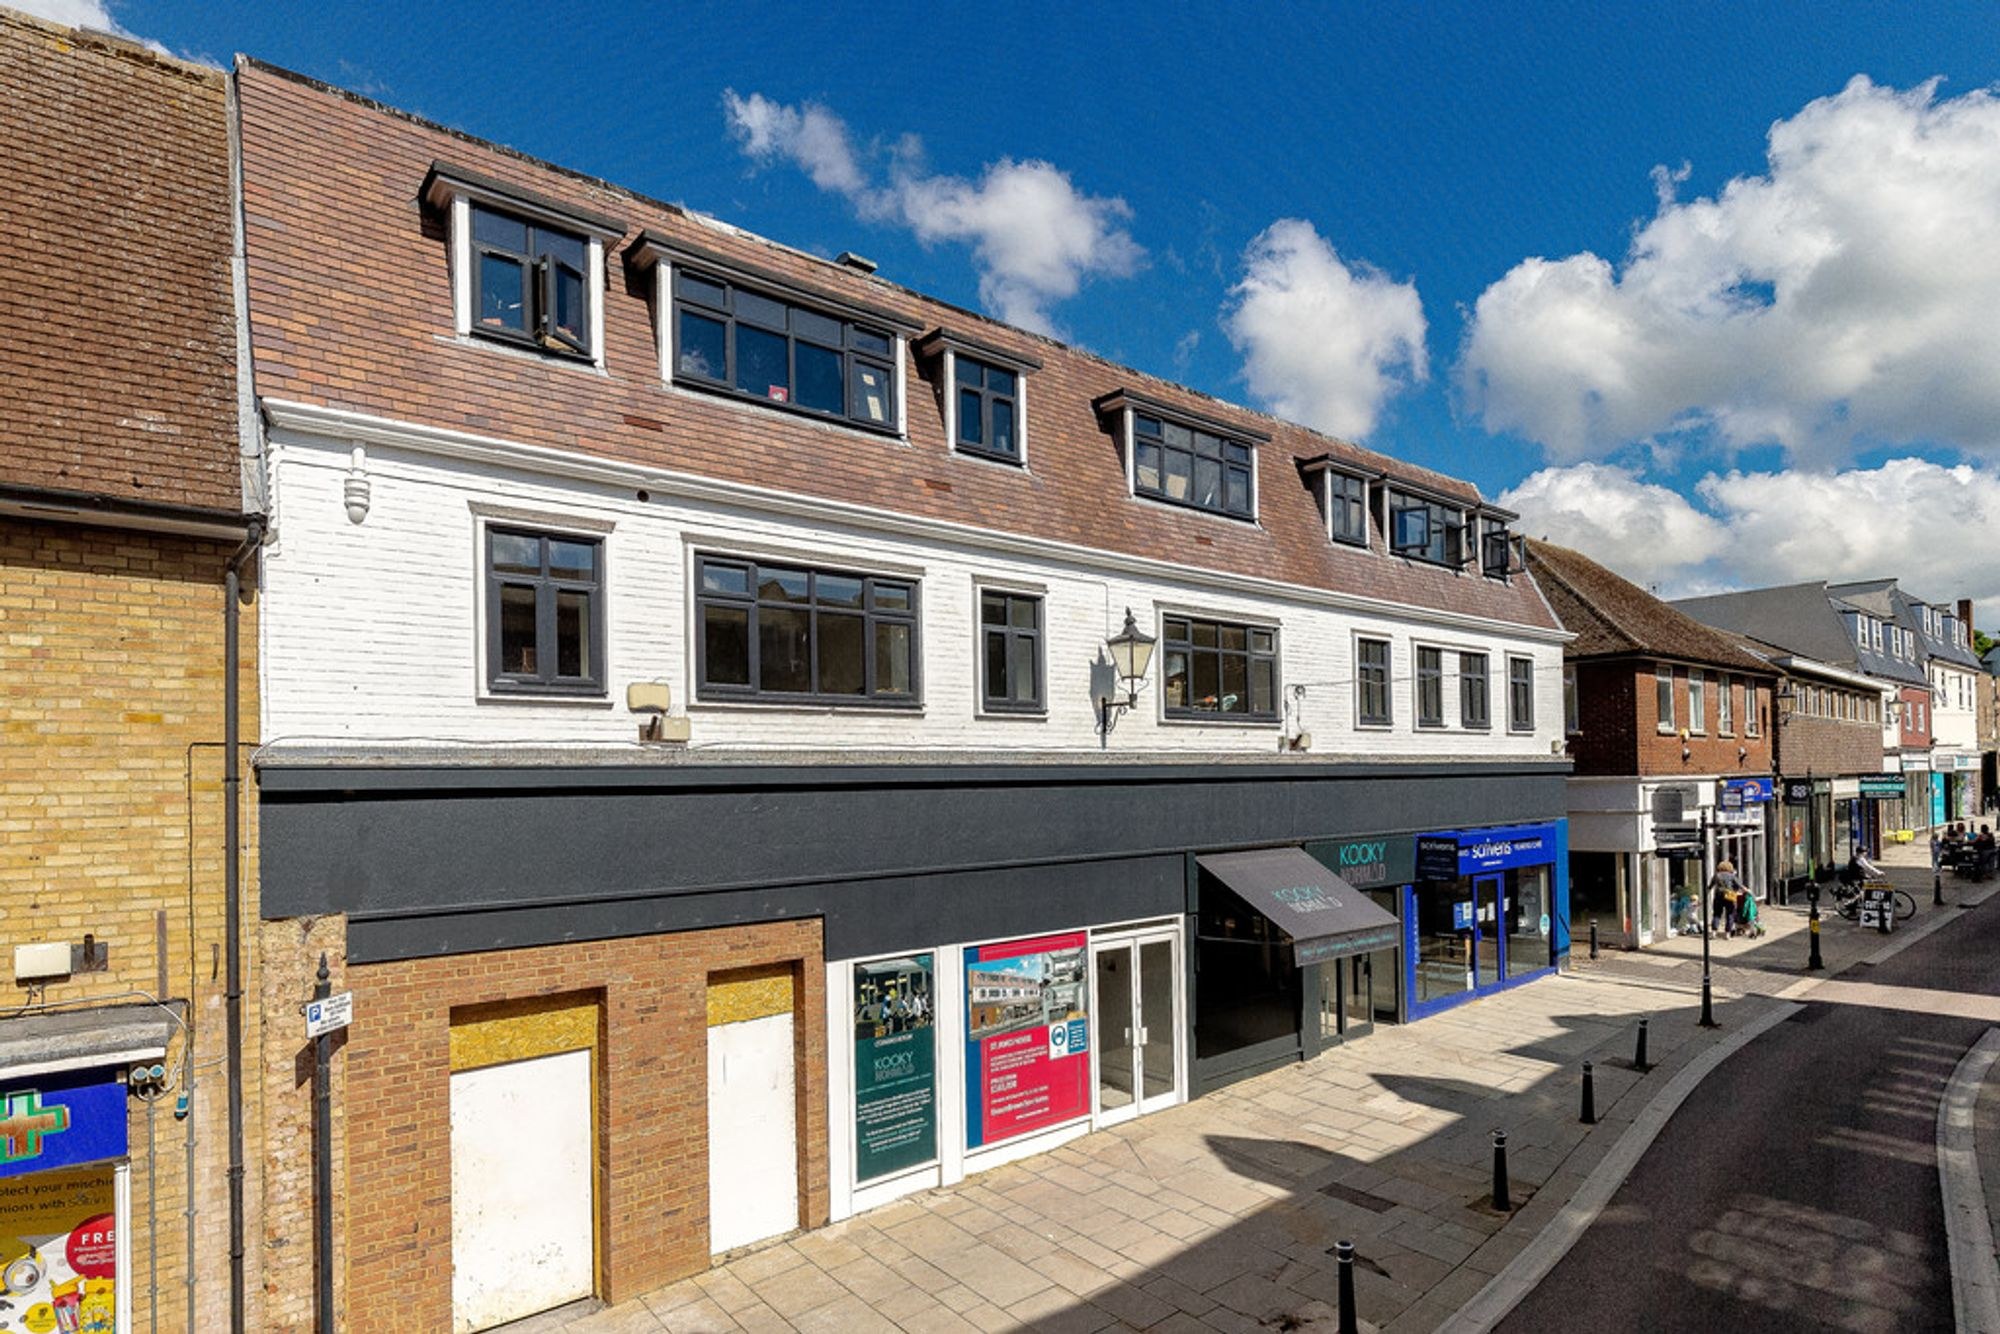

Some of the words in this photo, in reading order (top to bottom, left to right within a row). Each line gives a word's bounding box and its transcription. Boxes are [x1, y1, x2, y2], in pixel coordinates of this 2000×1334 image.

[1340, 842, 1386, 865] KOOKY
[1472, 838, 1511, 859] scrivens
[874, 1051, 913, 1070] KOOKY
[33, 1184, 62, 1195] your
[39, 1199, 65, 1210] with
